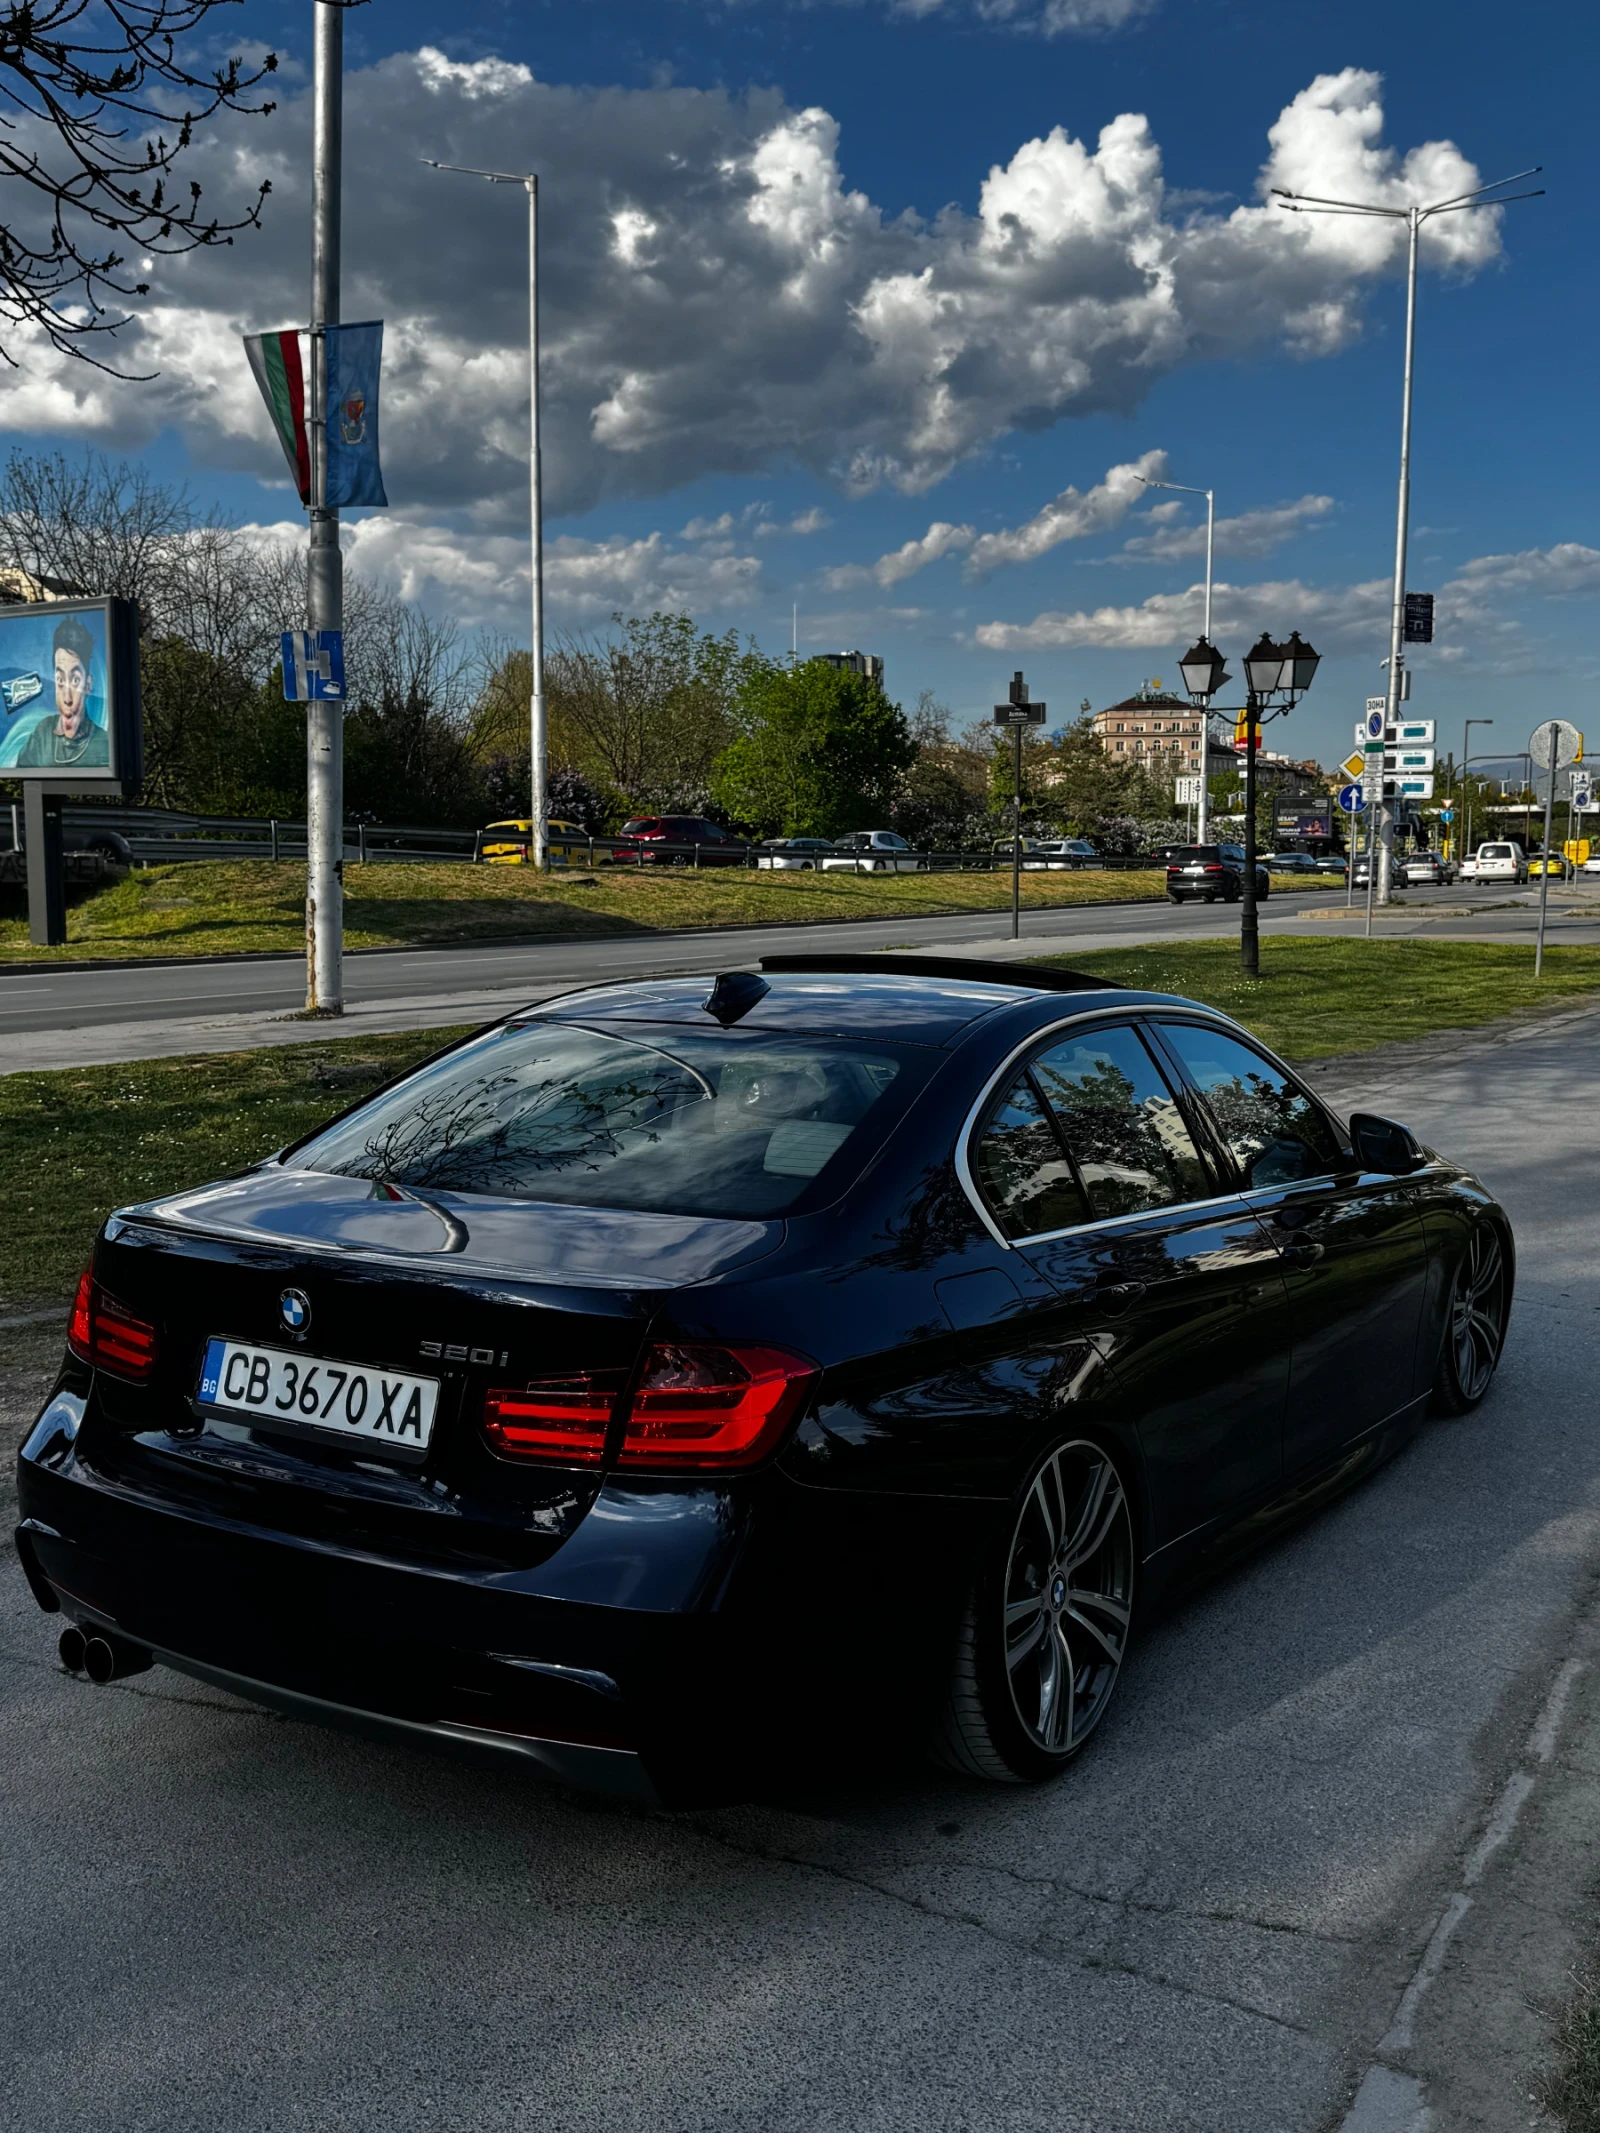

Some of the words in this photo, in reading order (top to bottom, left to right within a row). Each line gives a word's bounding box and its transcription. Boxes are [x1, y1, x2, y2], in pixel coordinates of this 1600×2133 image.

[1367, 699, 1384, 710] ЗОНА
[418, 1340, 509, 1367] 320i
[201, 1378, 217, 1394] BG
[223, 1351, 271, 1405] CB
[275, 1361, 369, 1426] 3670
[373, 1379, 423, 1440] XA
